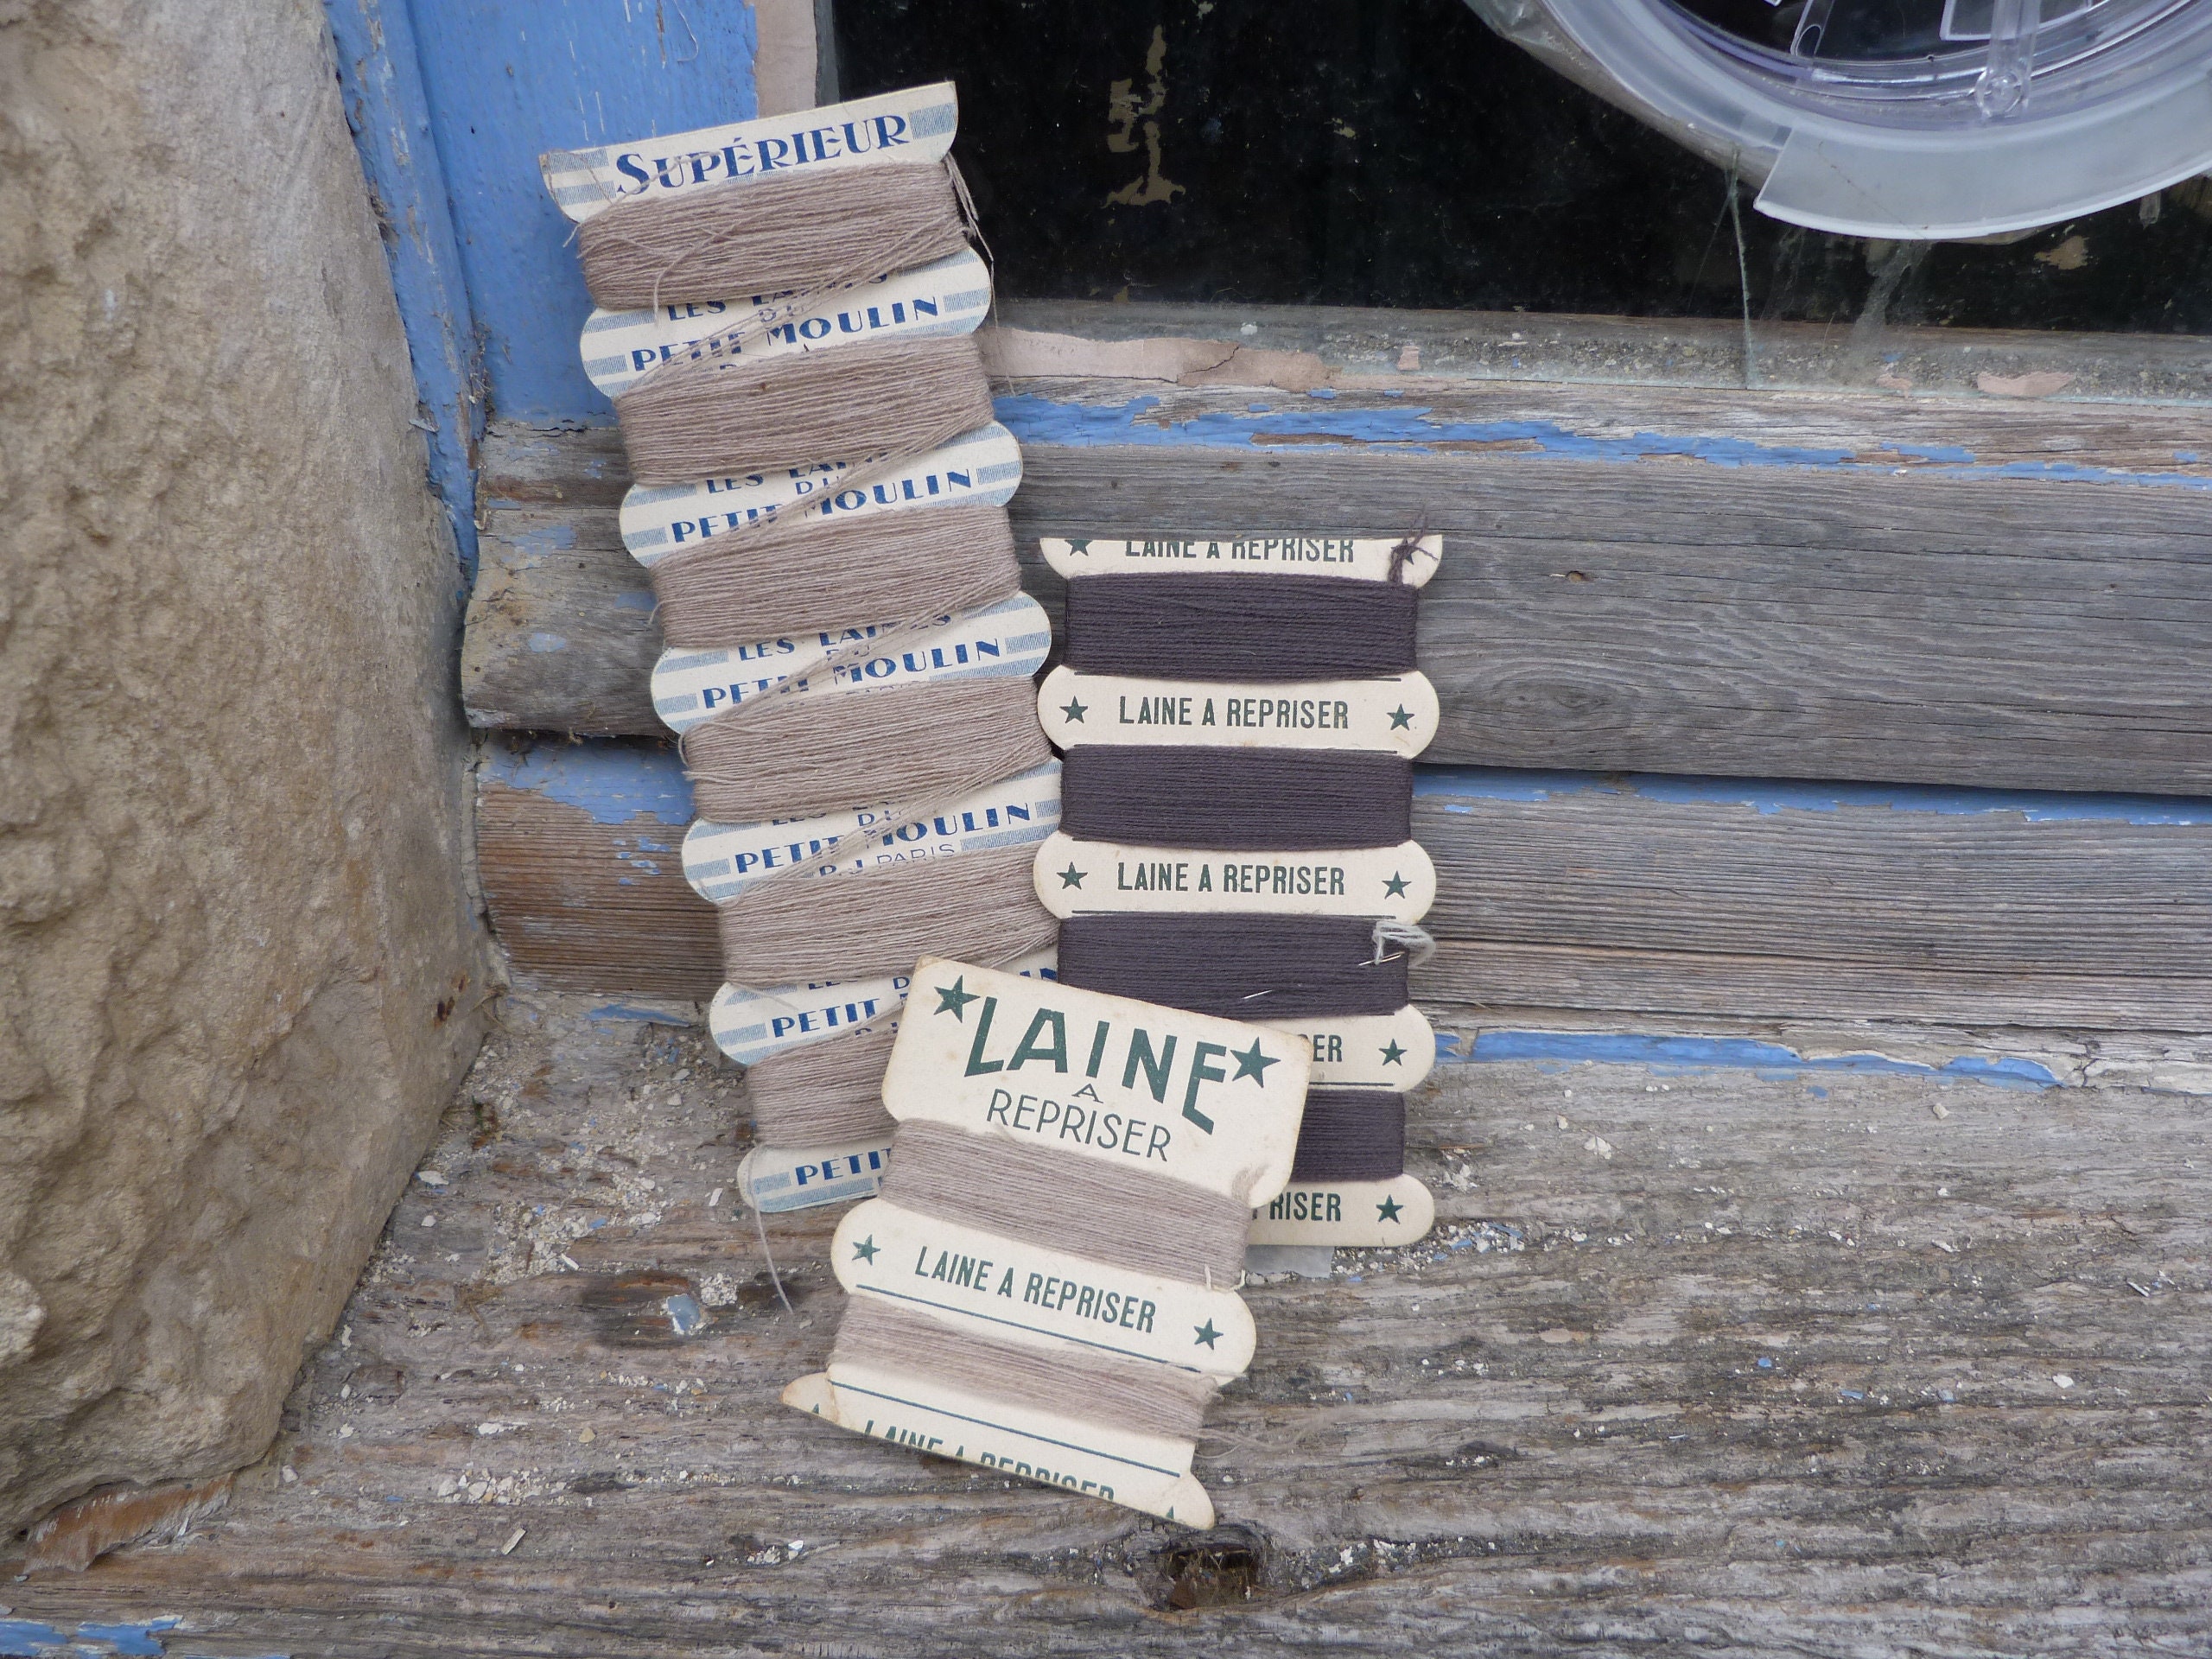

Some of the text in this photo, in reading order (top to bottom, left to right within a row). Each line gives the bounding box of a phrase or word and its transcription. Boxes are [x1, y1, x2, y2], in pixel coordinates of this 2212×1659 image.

[616, 114, 911, 196] SUPÉRIEUR
[666, 300, 727, 321] LES
[767, 296, 938, 346] MOULIN
[706, 474, 765, 494] LES
[671, 468, 972, 543] PETIT MOULIN
[739, 638, 796, 661] LES
[831, 638, 1001, 684] MOULIN
[1119, 696, 1349, 729] LAINE A REPRISER
[735, 835, 845, 874] PETIT
[876, 843, 956, 868] PARIS
[1117, 861, 1344, 895] LAINE A REPRISER
[772, 997, 880, 1039] PETIT
[963, 995, 1227, 1135] LAINE
[1071, 1083, 1104, 1104] A
[986, 1088, 1172, 1162] REPRISER
[1252, 1191, 1342, 1223] RISER
[914, 1245, 1157, 1334] LAINE A REPRISER
